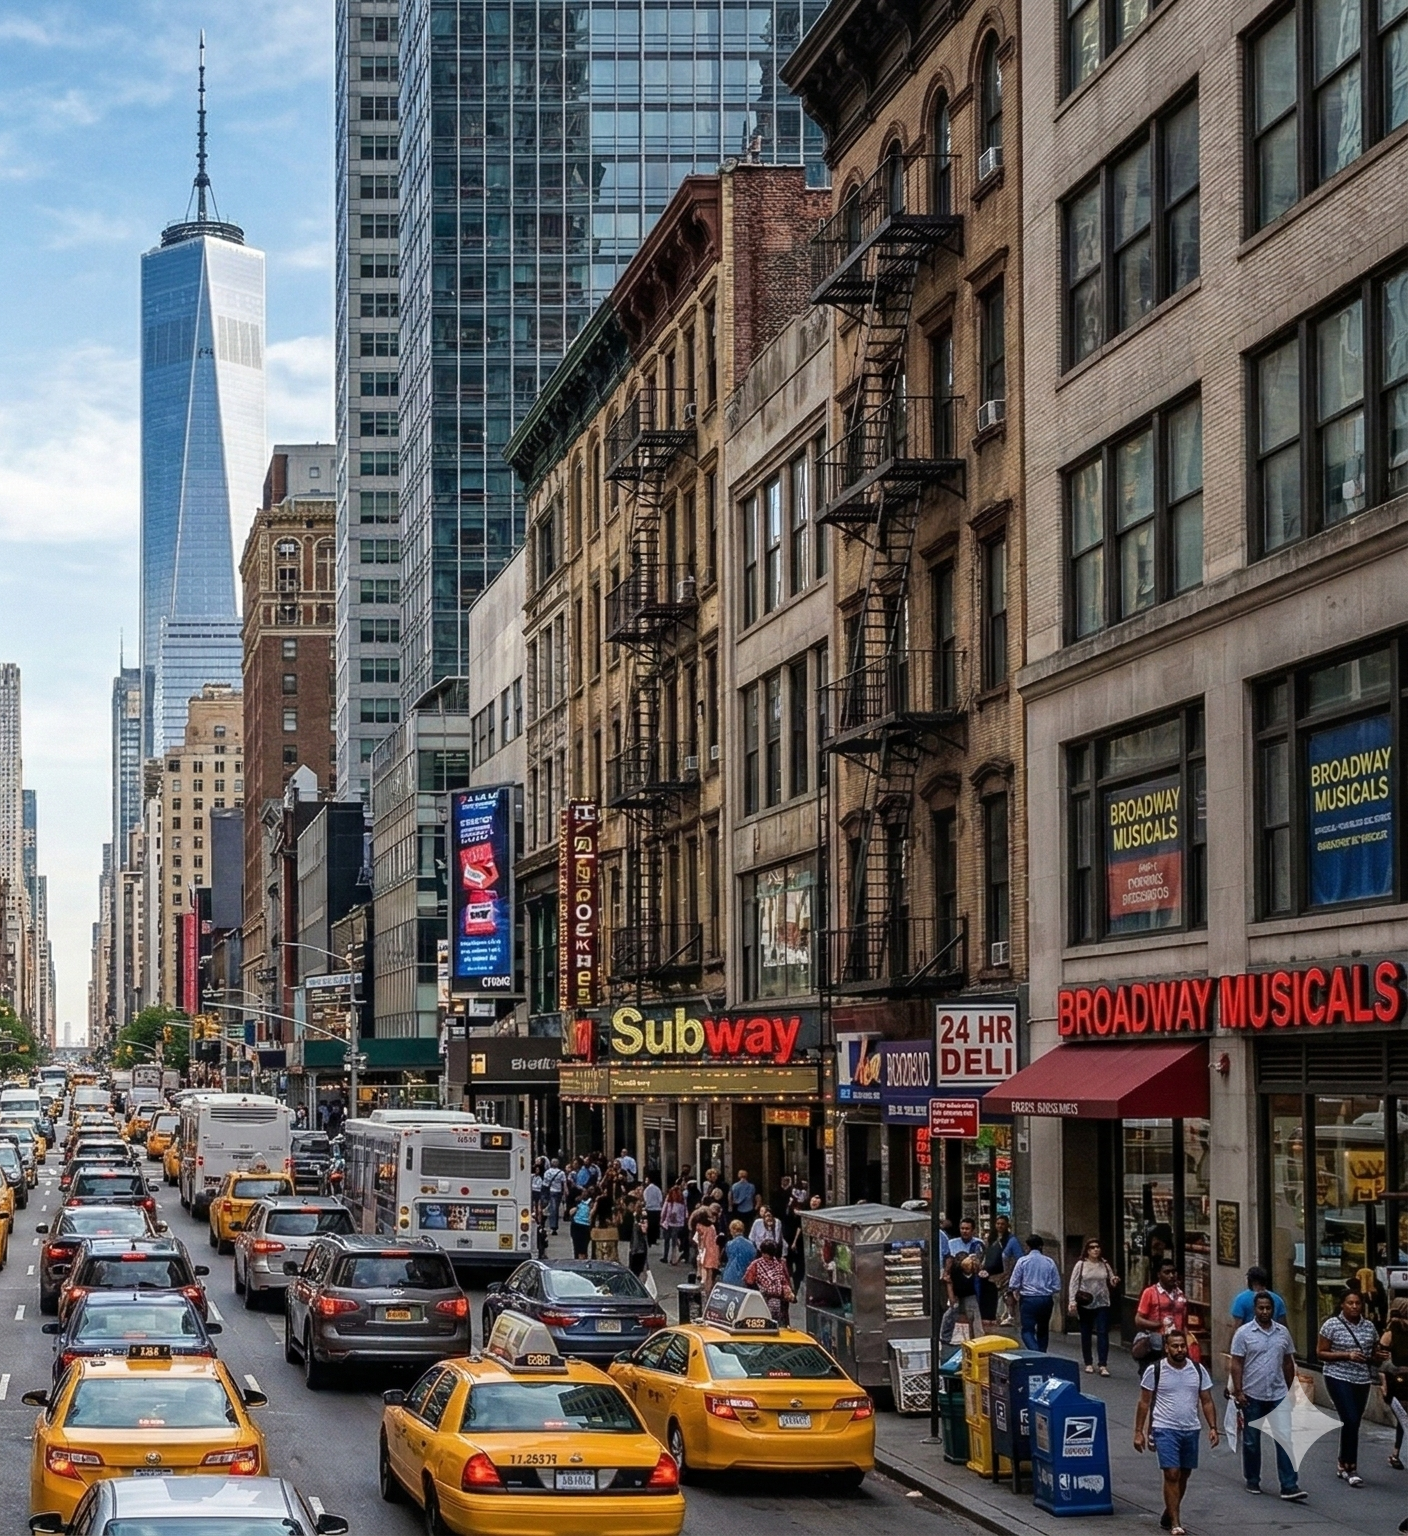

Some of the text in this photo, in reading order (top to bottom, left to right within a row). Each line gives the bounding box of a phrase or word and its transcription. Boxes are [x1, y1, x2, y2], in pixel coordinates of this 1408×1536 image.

[1311, 745, 1391, 787] BROADWAY
[1110, 785, 1181, 826] BROADWAY
[1315, 775, 1389, 813] MUSICALS
[1113, 815, 1178, 851] MUSICALS
[1058, 960, 1400, 1036] BROADWAY MUSICALS
[611, 1006, 801, 1064] Subway
[940, 1015, 1013, 1044] 24 HR
[941, 1048, 1012, 1076] DELI
